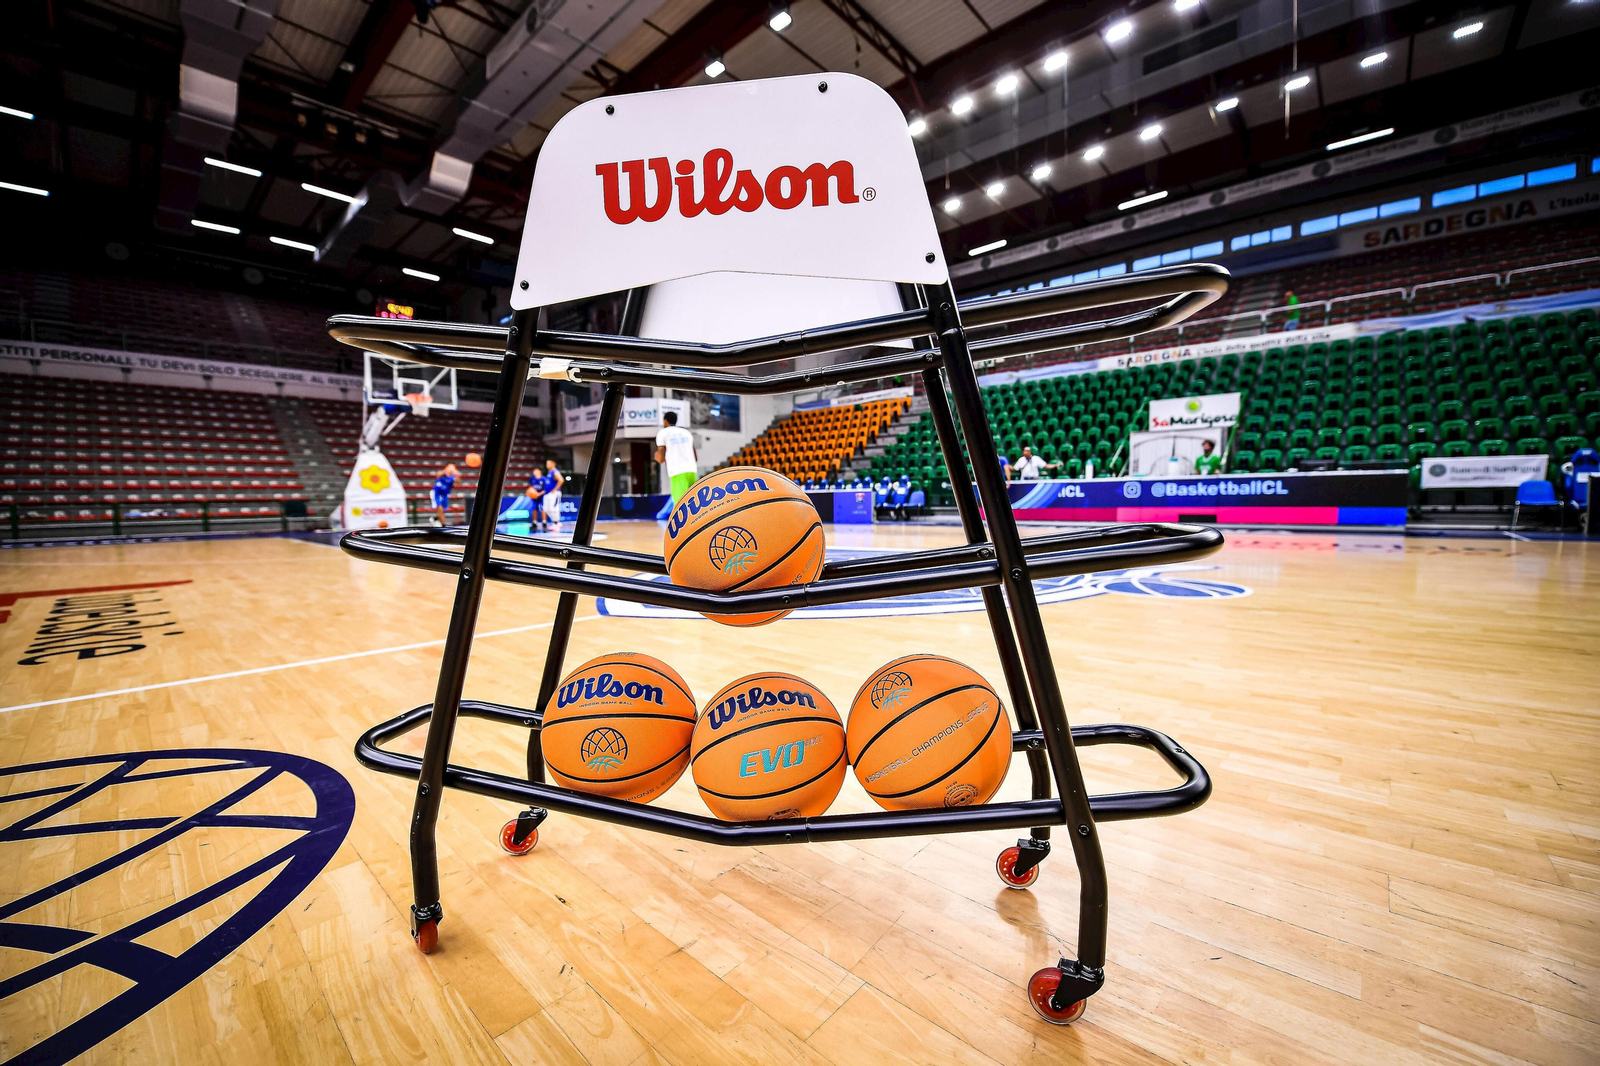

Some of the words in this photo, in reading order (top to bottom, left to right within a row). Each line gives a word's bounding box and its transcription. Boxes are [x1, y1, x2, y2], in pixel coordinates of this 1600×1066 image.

[595, 148, 859, 225] Wilson
[1363, 200, 1537, 248] SARDEGNA
[138, 357, 158, 368] TU
[161, 359, 196, 371] DEVI
[198, 362, 236, 375] SOLO
[1117, 348, 1191, 368] SARDEGNA
[709, 501, 725, 512] GAME
[726, 496, 741, 504] BALL
[1150, 480, 1289, 498] @BasketballCL
[667, 477, 770, 540] Wilson
[557, 673, 664, 709] Wilson
[707, 686, 817, 731] Wilson
[739, 740, 805, 778] EVO
[868, 754, 912, 784] BASKETBALL
[911, 719, 964, 757] CHAMPIONS
[963, 701, 989, 724] LEAGUE
